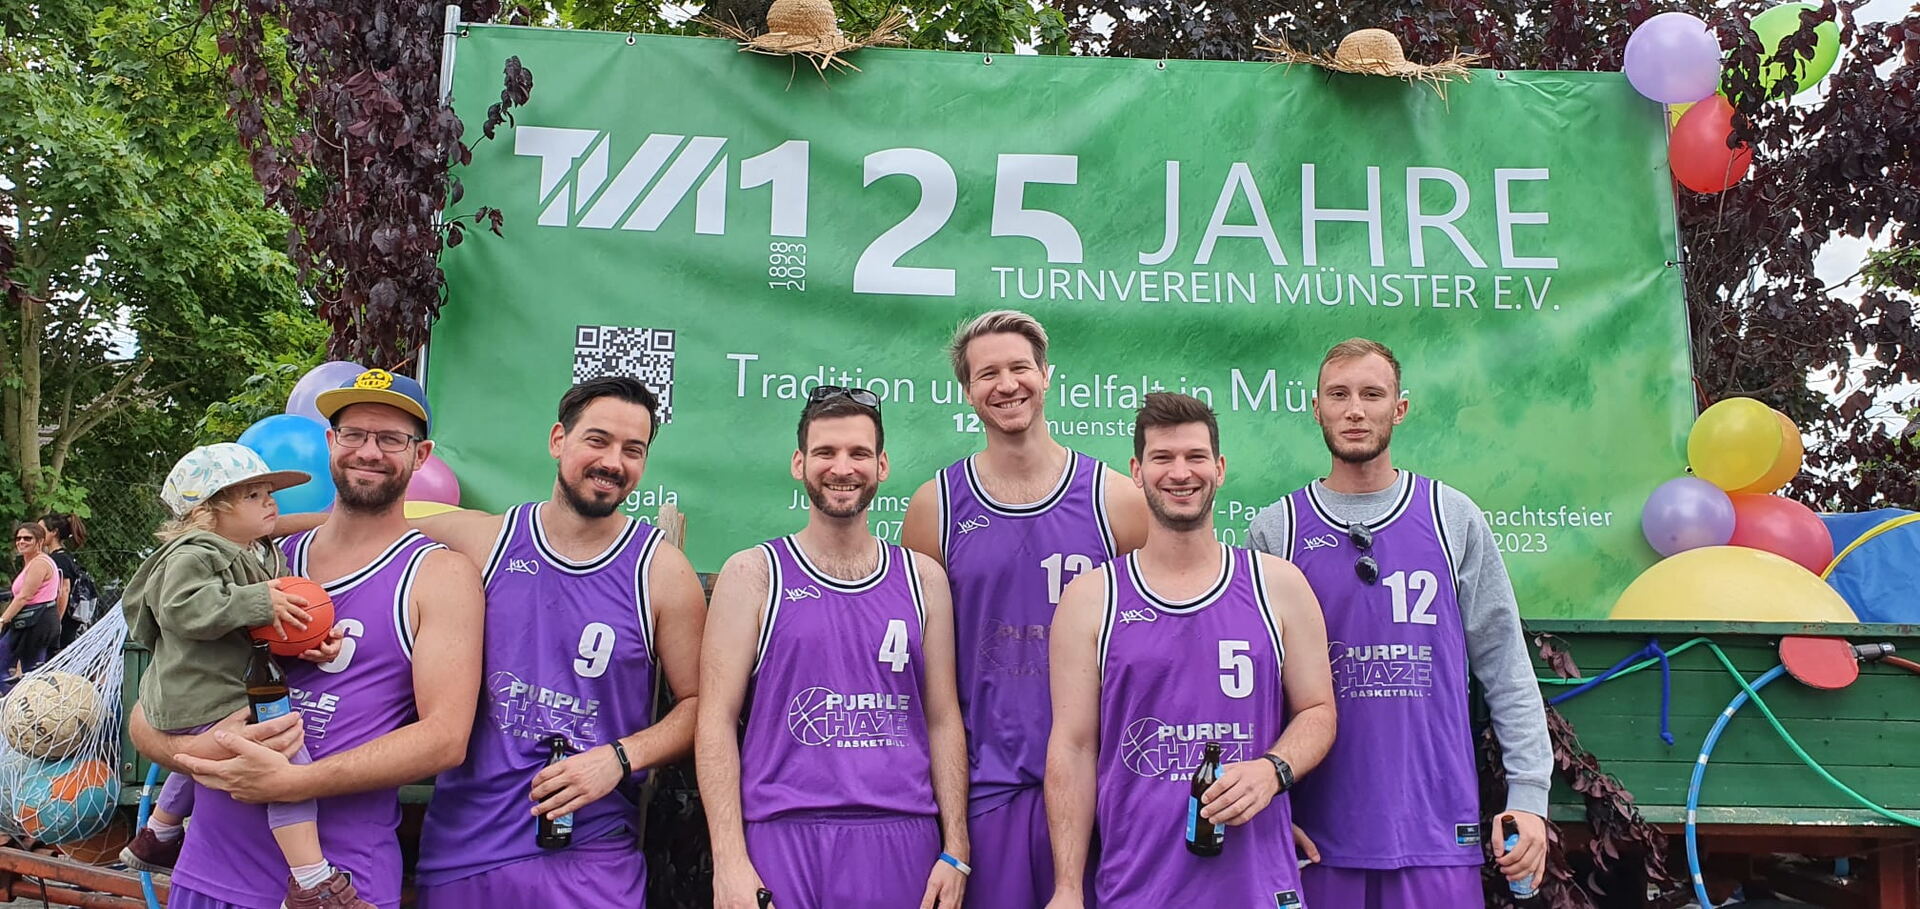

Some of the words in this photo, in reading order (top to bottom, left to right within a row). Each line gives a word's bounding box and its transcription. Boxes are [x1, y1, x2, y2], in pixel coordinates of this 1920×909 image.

[1137, 159, 1559, 270] JAHRE
[768, 242, 788, 289] 1898
[786, 243, 807, 291] 2023
[991, 266, 1257, 304] TURNVEREIN
[1273, 266, 1479, 309] MÜNSTER
[1494, 275, 1560, 311] E.V.
[1382, 570, 1438, 625] 12
[573, 621, 616, 678] 9
[878, 619, 910, 672] 4
[1218, 640, 1254, 698] 5
